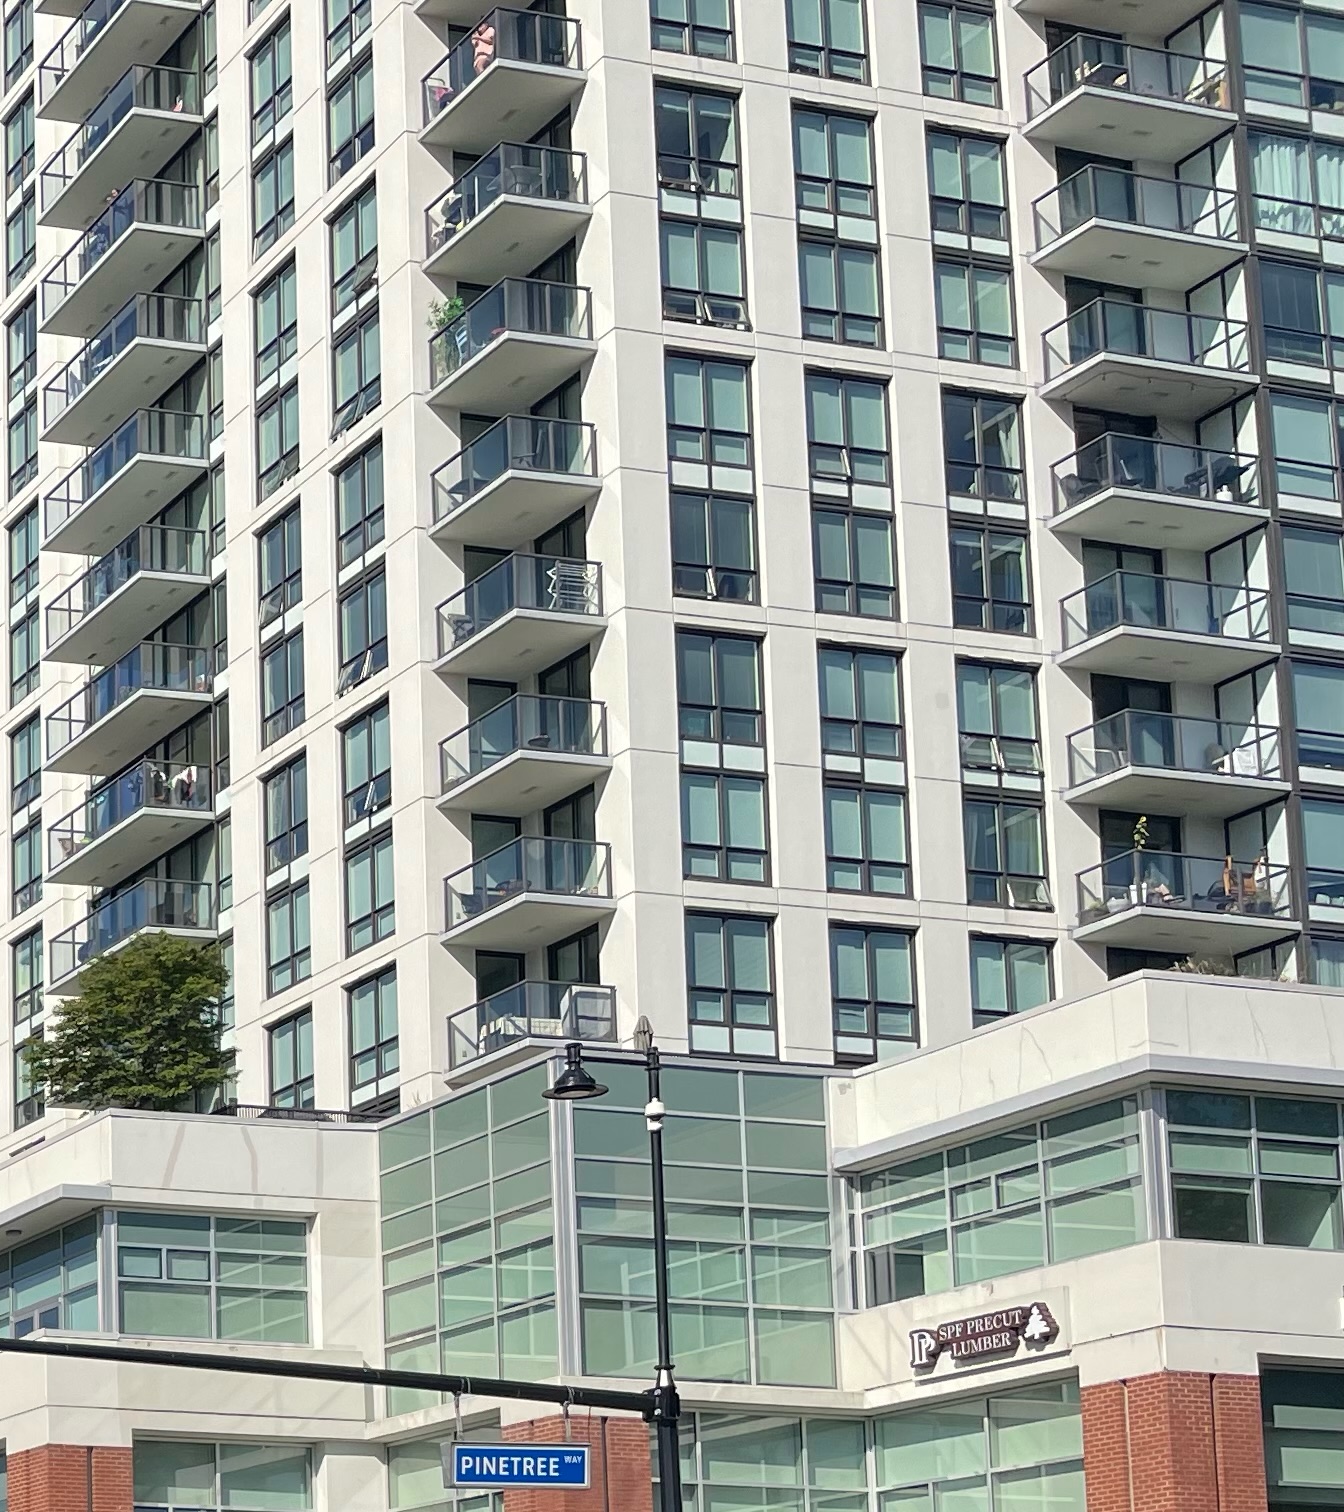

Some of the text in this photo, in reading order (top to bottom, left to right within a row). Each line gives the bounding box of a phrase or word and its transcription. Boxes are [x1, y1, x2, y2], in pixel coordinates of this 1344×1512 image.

[938, 1309, 1023, 1342] SPF PRECUT
[952, 1331, 1012, 1358] LUMBER
[461, 1455, 583, 1477] PINETREE WAY
